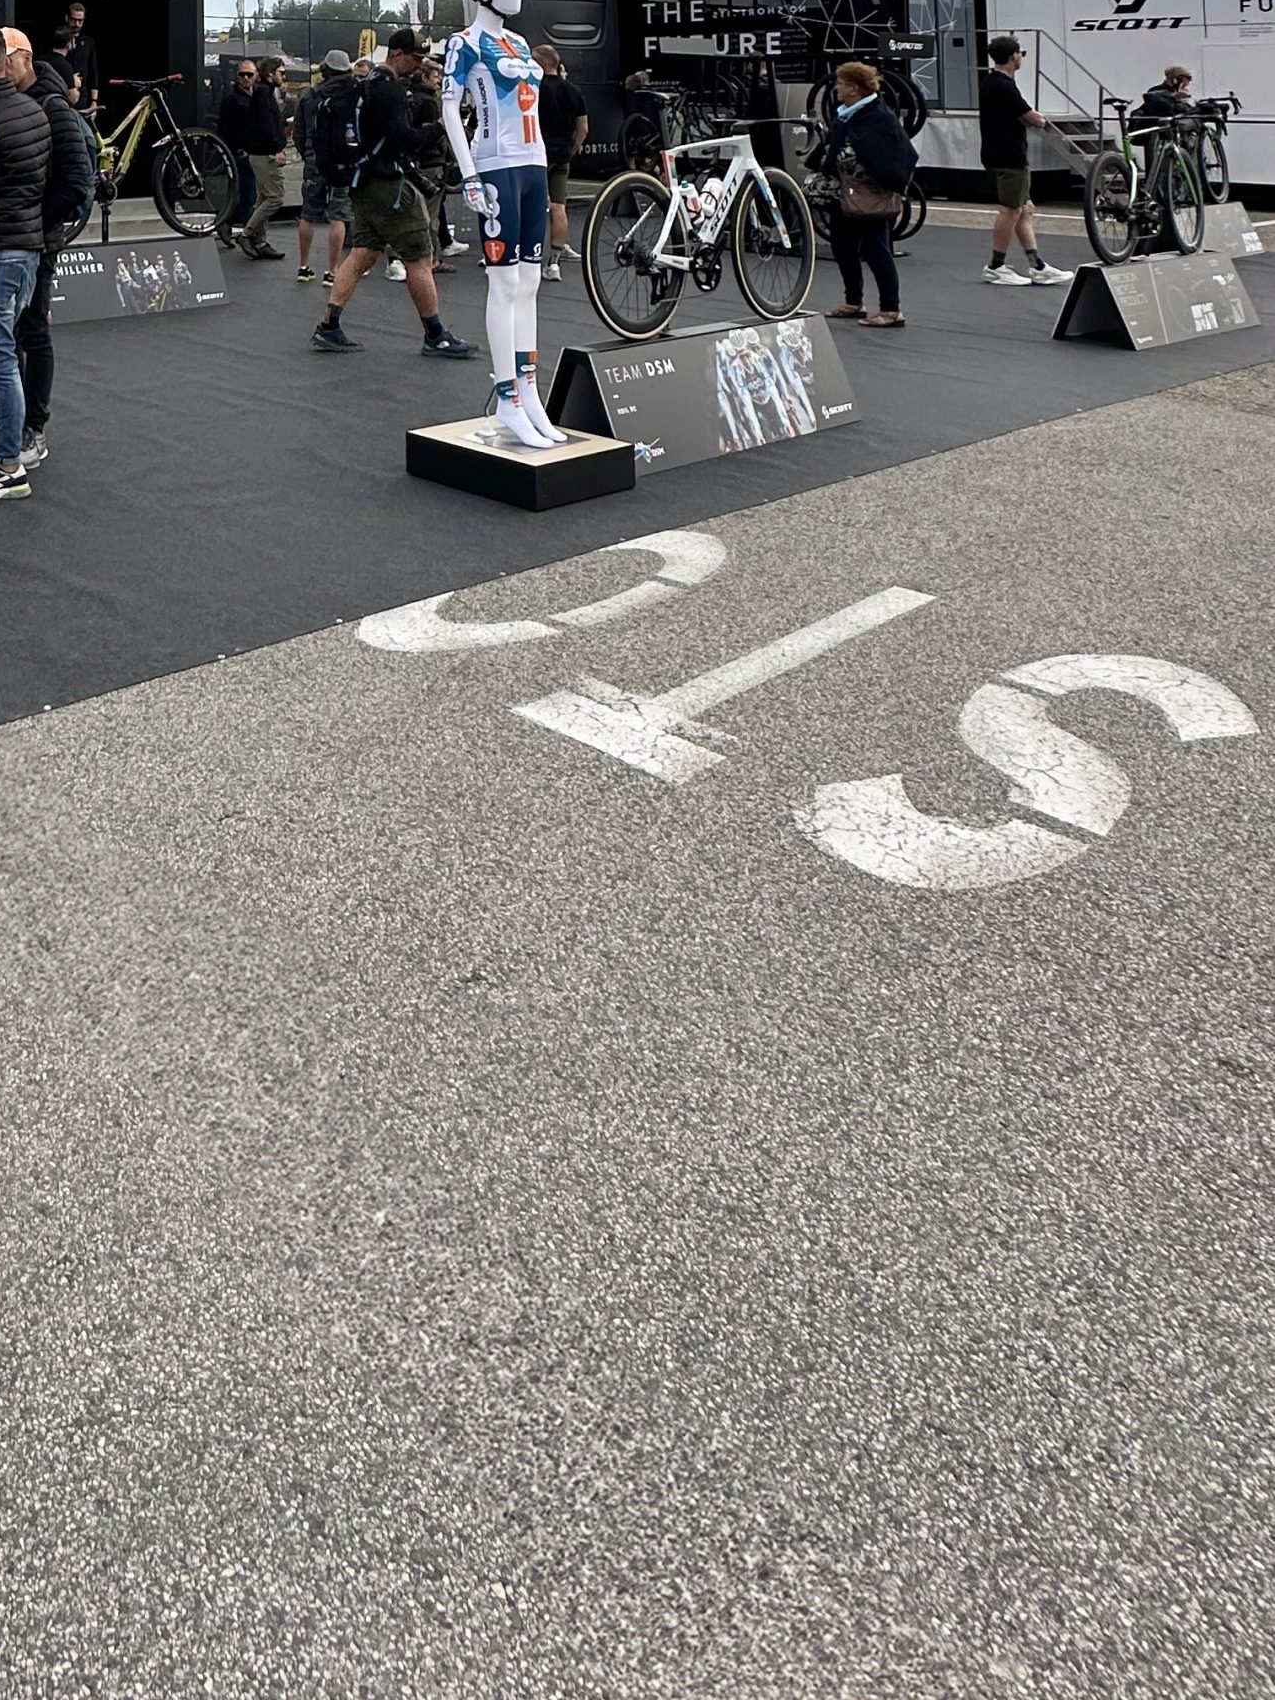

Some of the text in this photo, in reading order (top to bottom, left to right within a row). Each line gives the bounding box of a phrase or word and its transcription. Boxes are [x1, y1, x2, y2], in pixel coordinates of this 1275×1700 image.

[642, 0, 704, 25] THE
[1071, 17, 1191, 31] SCOTT
[644, 32, 783, 58] FURE
[709, 173, 739, 232] SCOTT
[605, 358, 675, 385] TEAM DSM
